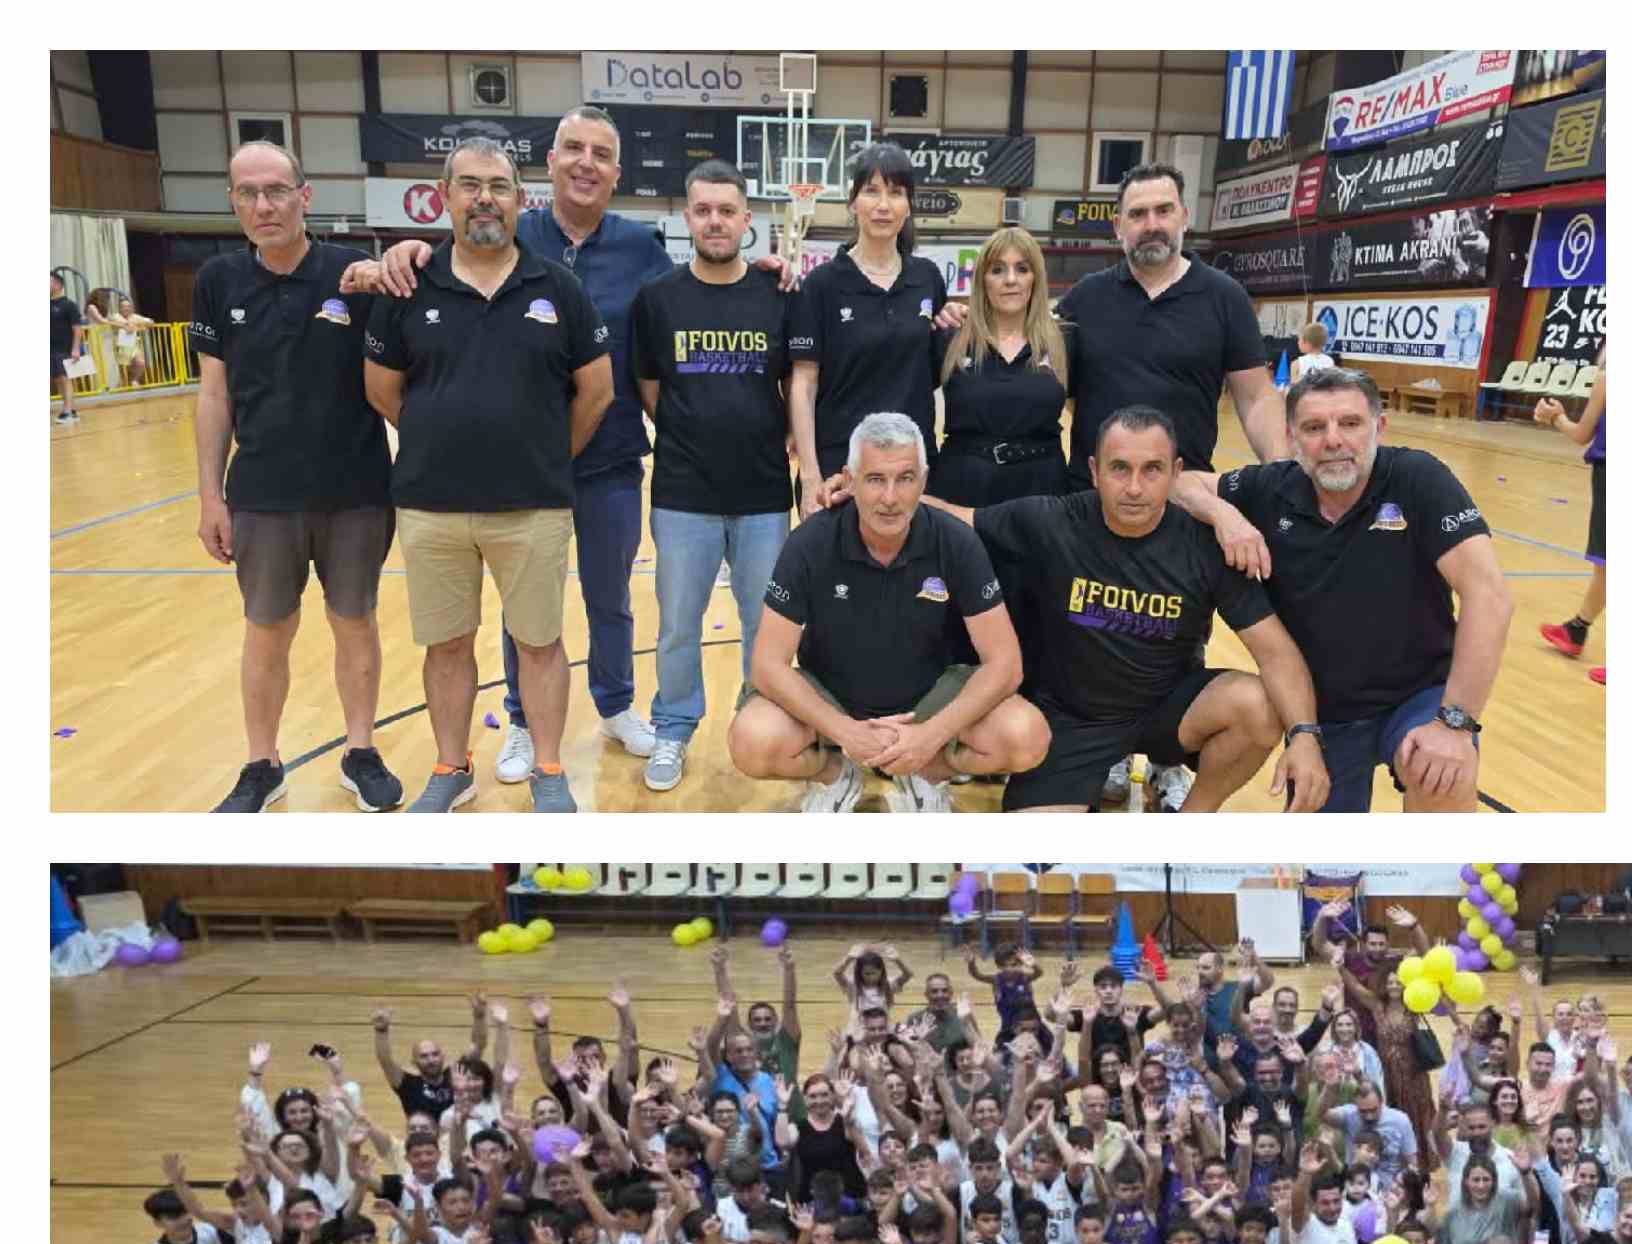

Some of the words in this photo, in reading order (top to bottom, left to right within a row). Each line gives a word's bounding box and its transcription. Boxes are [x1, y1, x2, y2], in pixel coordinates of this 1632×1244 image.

[607, 58, 743, 90] DataLab
[1354, 72, 1446, 129] RE/MAX
[1077, 203, 1120, 221] FOIV
[688, 331, 768, 351] FOIVOS
[1543, 324, 1570, 349] 23
[1086, 581, 1183, 619] FOIVOS
